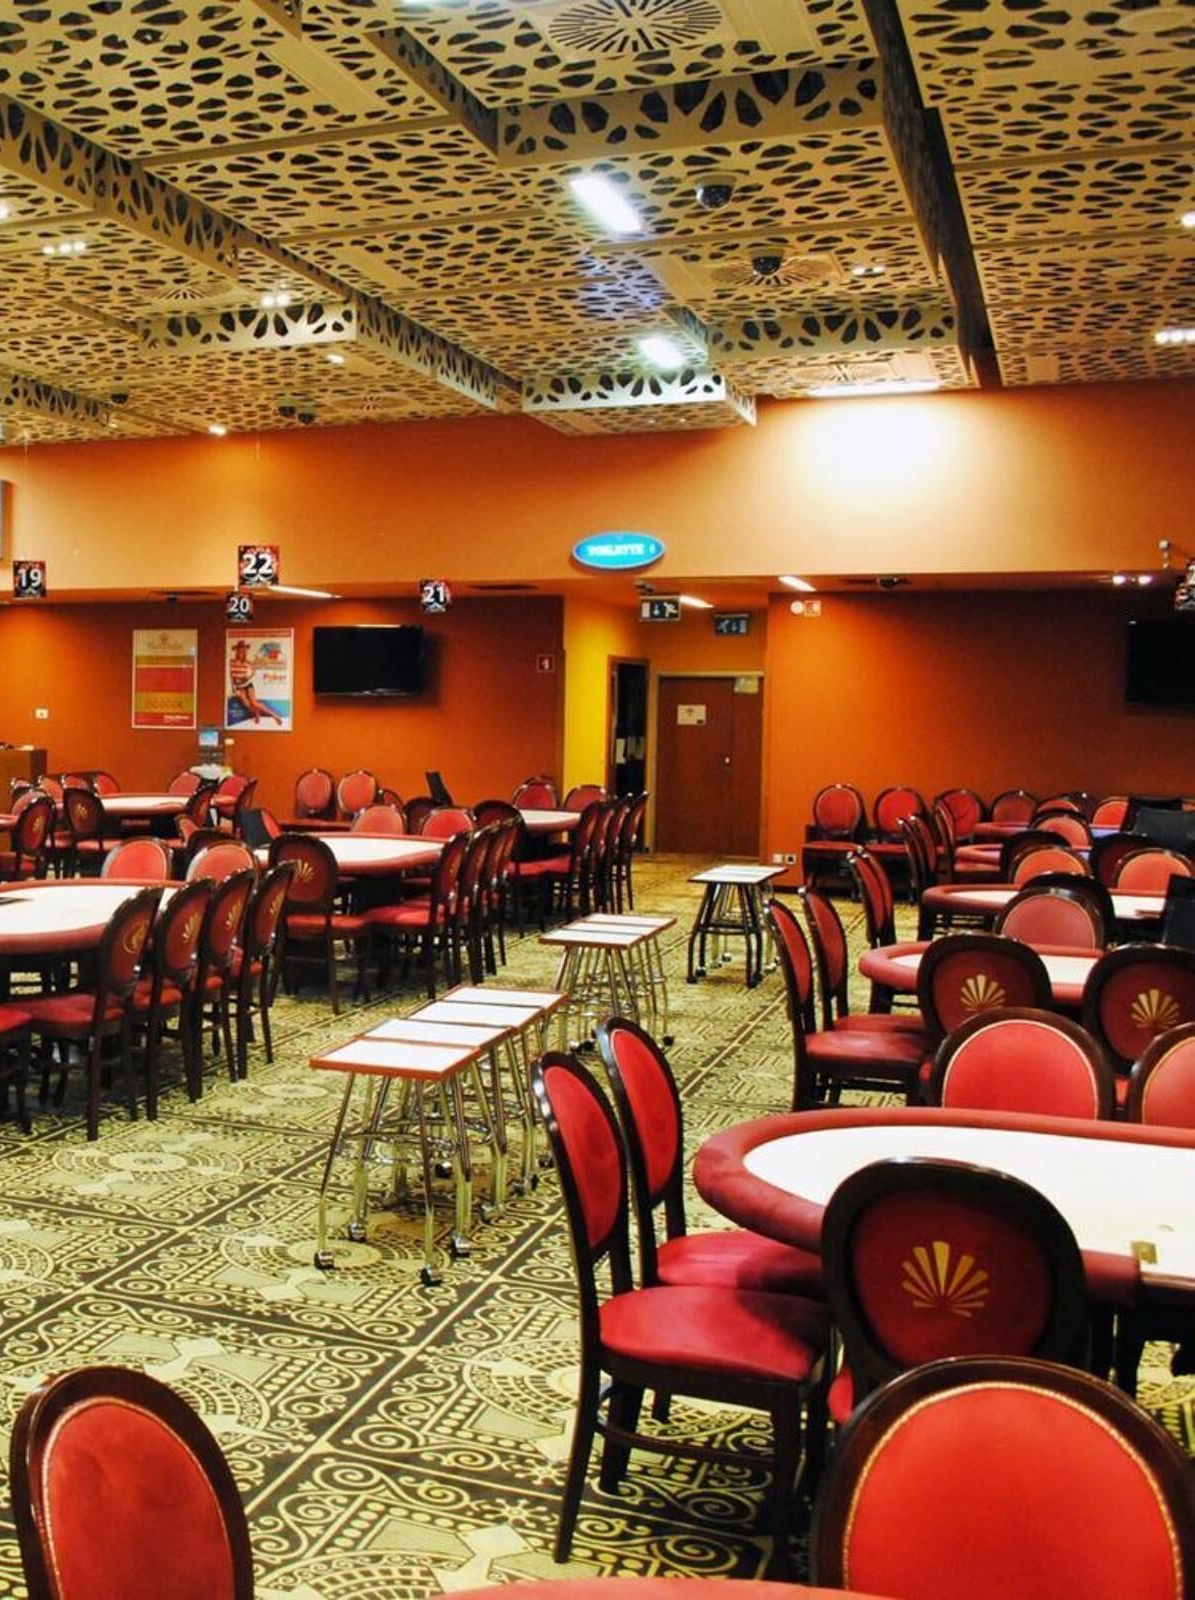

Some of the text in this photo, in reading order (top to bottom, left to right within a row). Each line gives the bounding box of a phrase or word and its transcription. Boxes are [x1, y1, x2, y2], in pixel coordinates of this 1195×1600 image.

[242, 552, 273, 575] 22
[17, 568, 42, 588] 19
[423, 585, 445, 603] 21
[228, 597, 251, 613] 20
